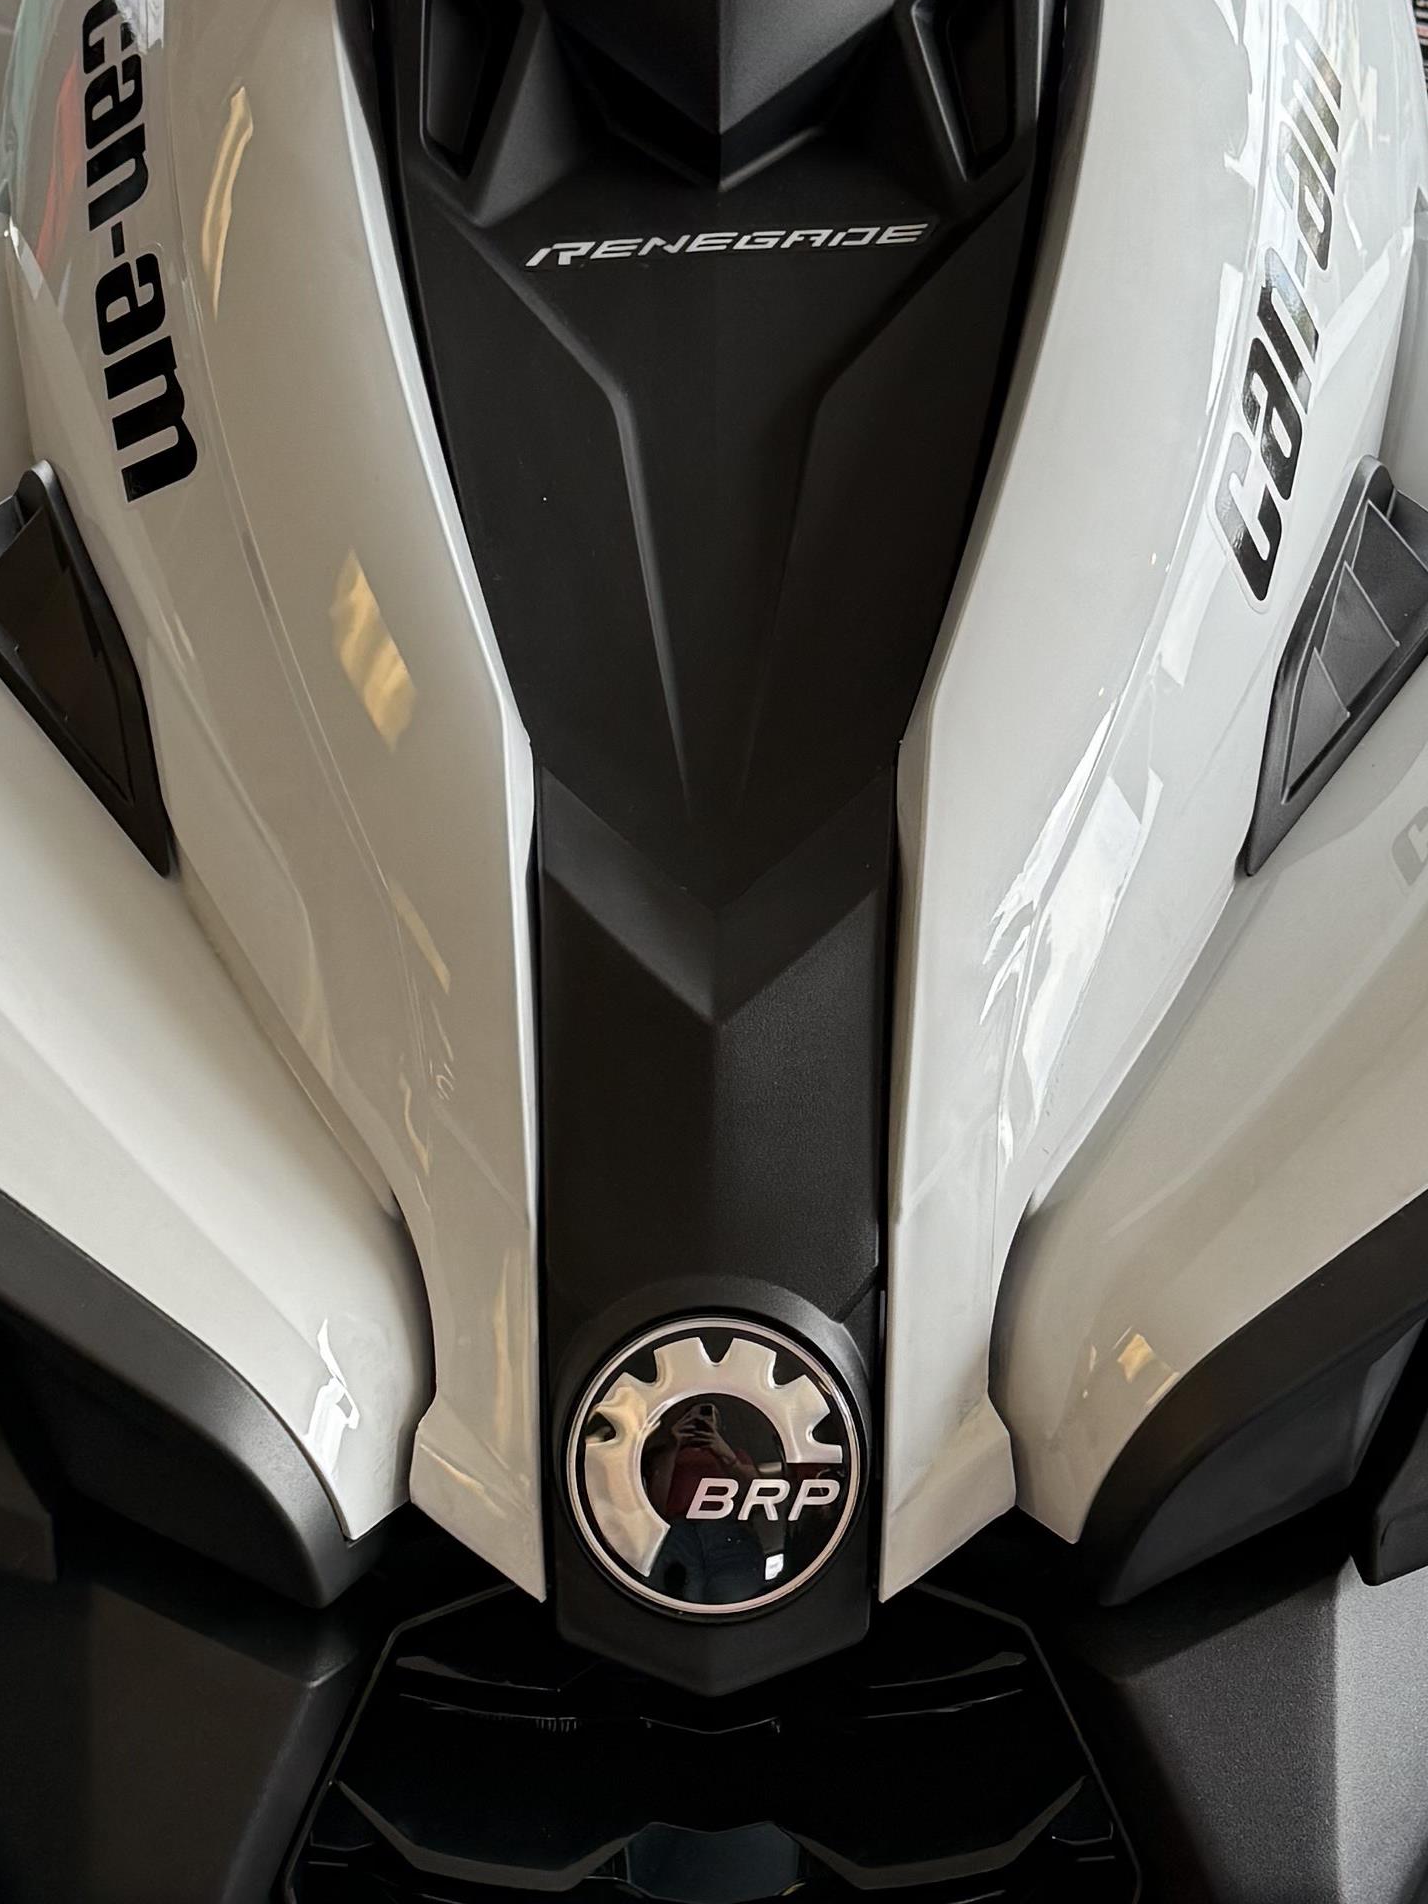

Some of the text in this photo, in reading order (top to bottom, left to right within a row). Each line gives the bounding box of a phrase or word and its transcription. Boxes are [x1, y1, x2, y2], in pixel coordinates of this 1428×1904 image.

[526, 223, 928, 267] RENEGADE
[1215, 3, 1342, 602] can-am
[685, 1477, 840, 1521] BRP
